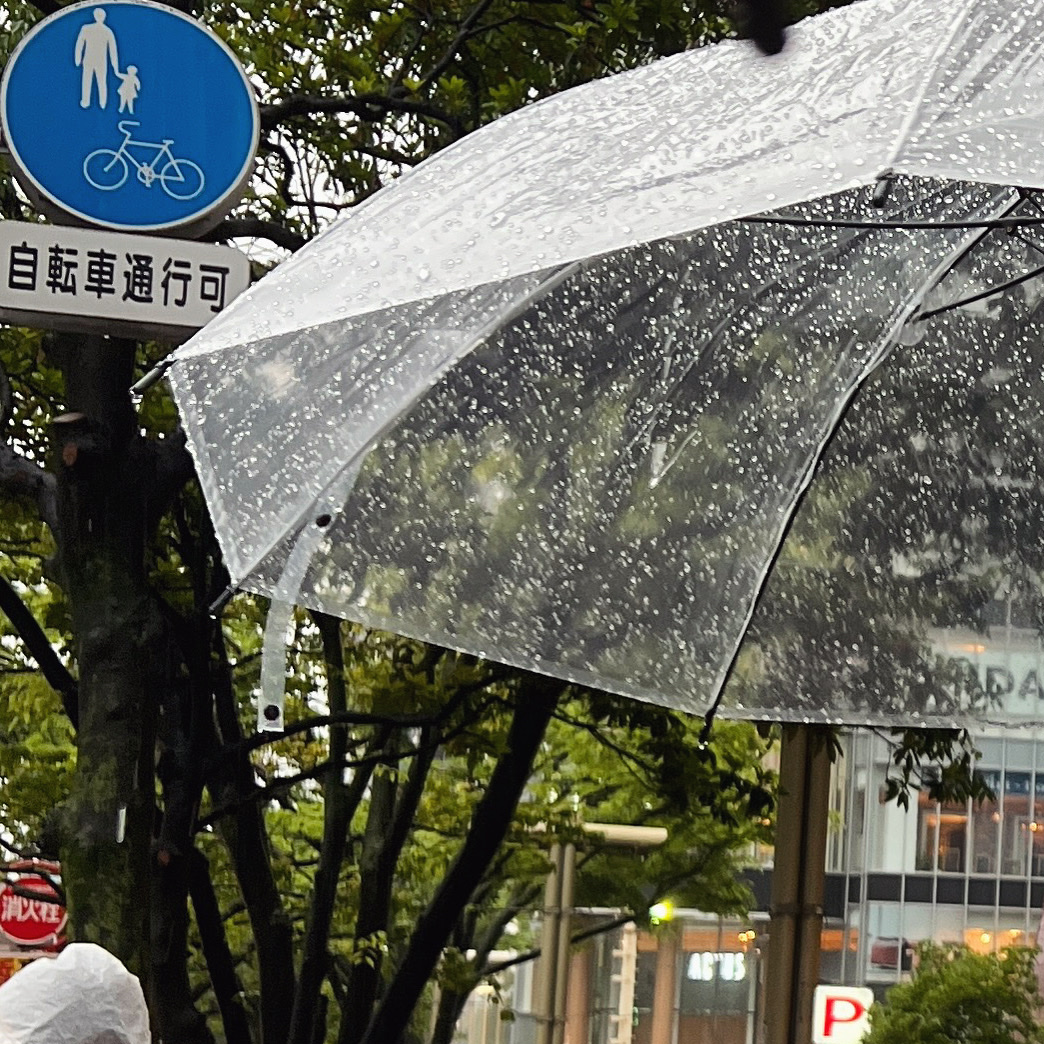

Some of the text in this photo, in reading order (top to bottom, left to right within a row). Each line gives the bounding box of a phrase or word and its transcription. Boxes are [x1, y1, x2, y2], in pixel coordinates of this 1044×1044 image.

[8, 241, 230, 313] 自転車通行可
[822, 995, 866, 1037] P
